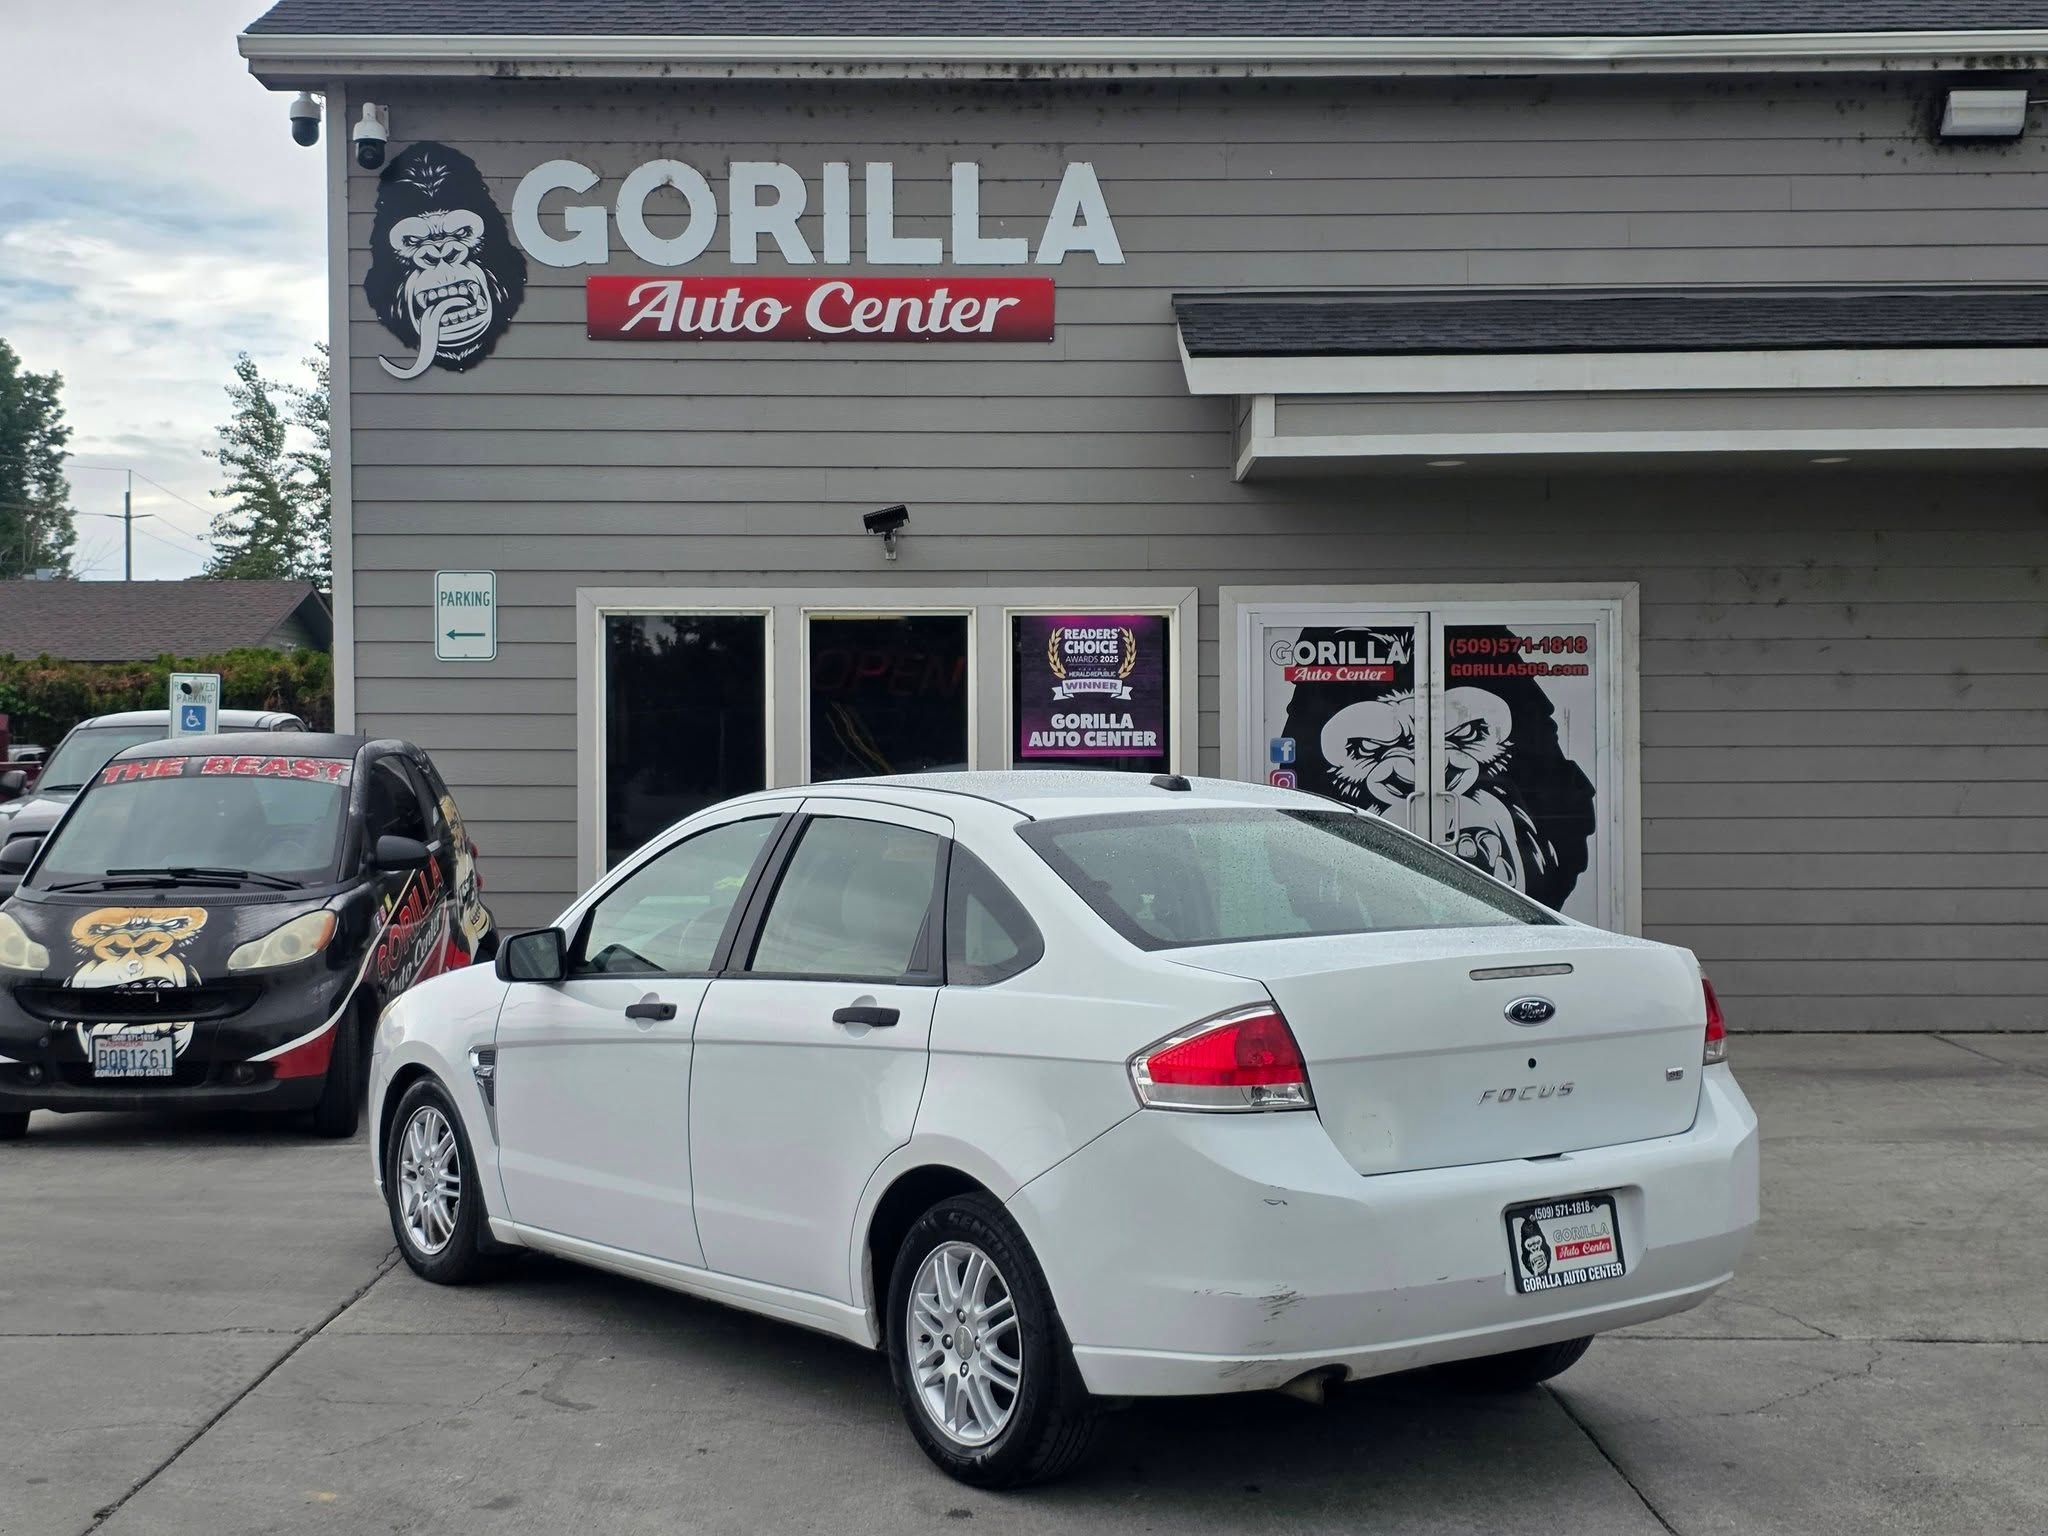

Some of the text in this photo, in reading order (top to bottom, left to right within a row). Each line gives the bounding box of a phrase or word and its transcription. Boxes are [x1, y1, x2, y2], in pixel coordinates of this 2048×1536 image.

[511, 159, 1126, 267] GORILLA
[620, 280, 1019, 335] Auto Center
[440, 591, 490, 607] PARKING
[1064, 628, 1120, 640] READERS'
[1064, 640, 1118, 654] CHOICE
[1270, 640, 1408, 666] GORILLA
[1450, 636, 1588, 656] (509)571-1818
[1065, 655, 1119, 663] AWARDS 2025
[1294, 667, 1386, 681] Auto Center
[1451, 662, 1588, 677] GORILLA509.com
[1065, 682, 1118, 690] WINNER
[176, 694, 212, 704] PARKING
[1051, 713, 1134, 729] GORILLA
[1029, 732, 1157, 747] AUTO CENTER
[101, 755, 349, 785] THE BEAST
[377, 853, 445, 984] GORILLA
[1520, 1001, 1547, 1020] Ford
[126, 1069, 144, 1077] AUTO
[146, 1068, 172, 1076] CENTER
[1477, 1082, 1575, 1105] FOCUS
[1534, 1200, 1591, 1221] (509) 571-1818
[1553, 1222, 1610, 1243] GORILLA
[1559, 1240, 1610, 1259] Auto Center
[1563, 1267, 1587, 1286] AUTO
[1589, 1262, 1624, 1281] CENTER
